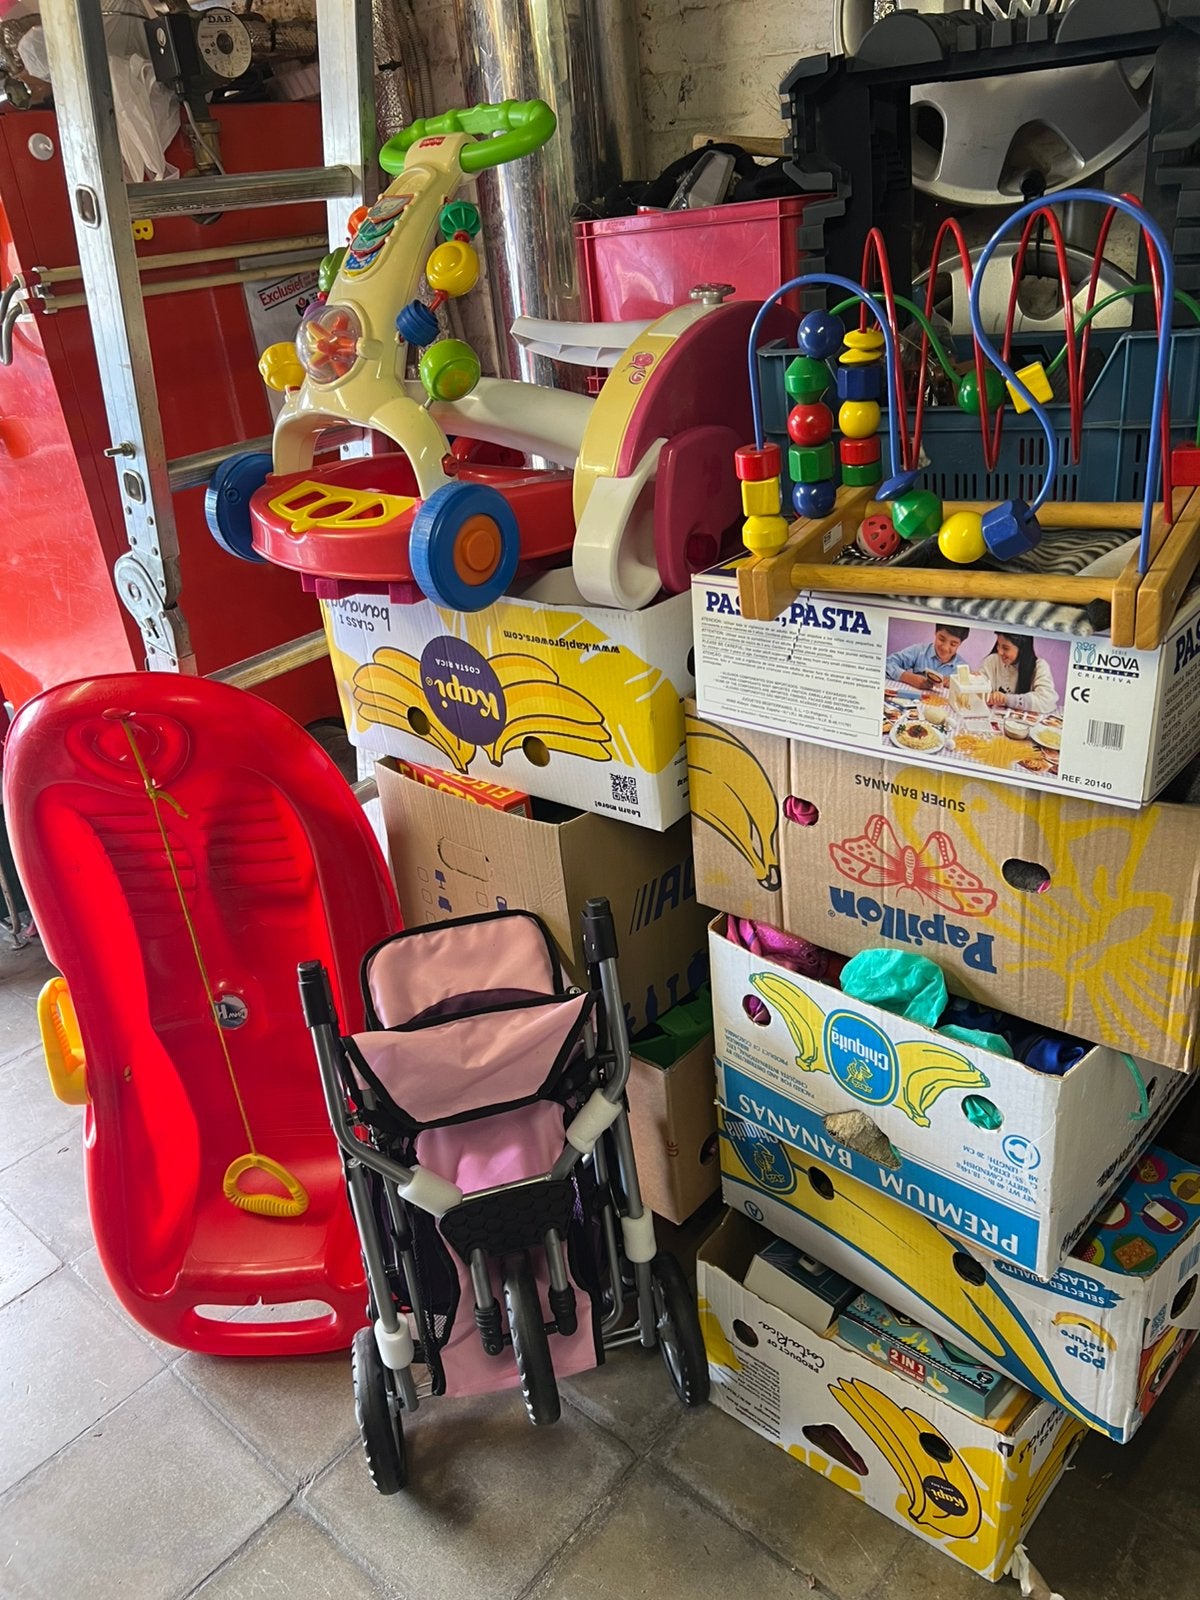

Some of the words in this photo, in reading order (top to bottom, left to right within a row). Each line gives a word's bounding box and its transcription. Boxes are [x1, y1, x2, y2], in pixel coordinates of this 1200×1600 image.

[208, 15, 232, 23] DAB
[258, 276, 304, 306] Exclusief
[345, 616, 375, 633] CLASS
[789, 603, 872, 636] PASTA
[503, 630, 621, 654] www.kapigrowers.com
[435, 658, 454, 669] RICA
[454, 662, 481, 675] COSTA
[1097, 653, 1139, 671] NOVA
[1077, 672, 1131, 684] CRIATIVA
[433, 674, 500, 721] Kapi
[854, 774, 918, 800] BANANAS
[1061, 773, 1082, 785] REF.
[1084, 778, 1112, 790] 20140
[618, 806, 641, 818] Learn
[921, 791, 966, 813] SUPER
[831, 1031, 889, 1071] Chiquita
[738, 1093, 853, 1170] BANANAS
[963, 1145, 976, 1155] CM
[963, 1159, 1003, 1182] CAVENDISH
[988, 1164, 1011, 1178] EXTRA
[1022, 1194, 1036, 1204] NET
[878, 1168, 1019, 1256] PREMIUM
[1049, 1280, 1105, 1304] SELECTED
[779, 1346, 819, 1374] PRODUCT
[890, 1349, 899, 1361] 2
[901, 1354, 915, 1370] IN
[917, 1364, 924, 1376] 1
[930, 1488, 965, 1509] Kapi
